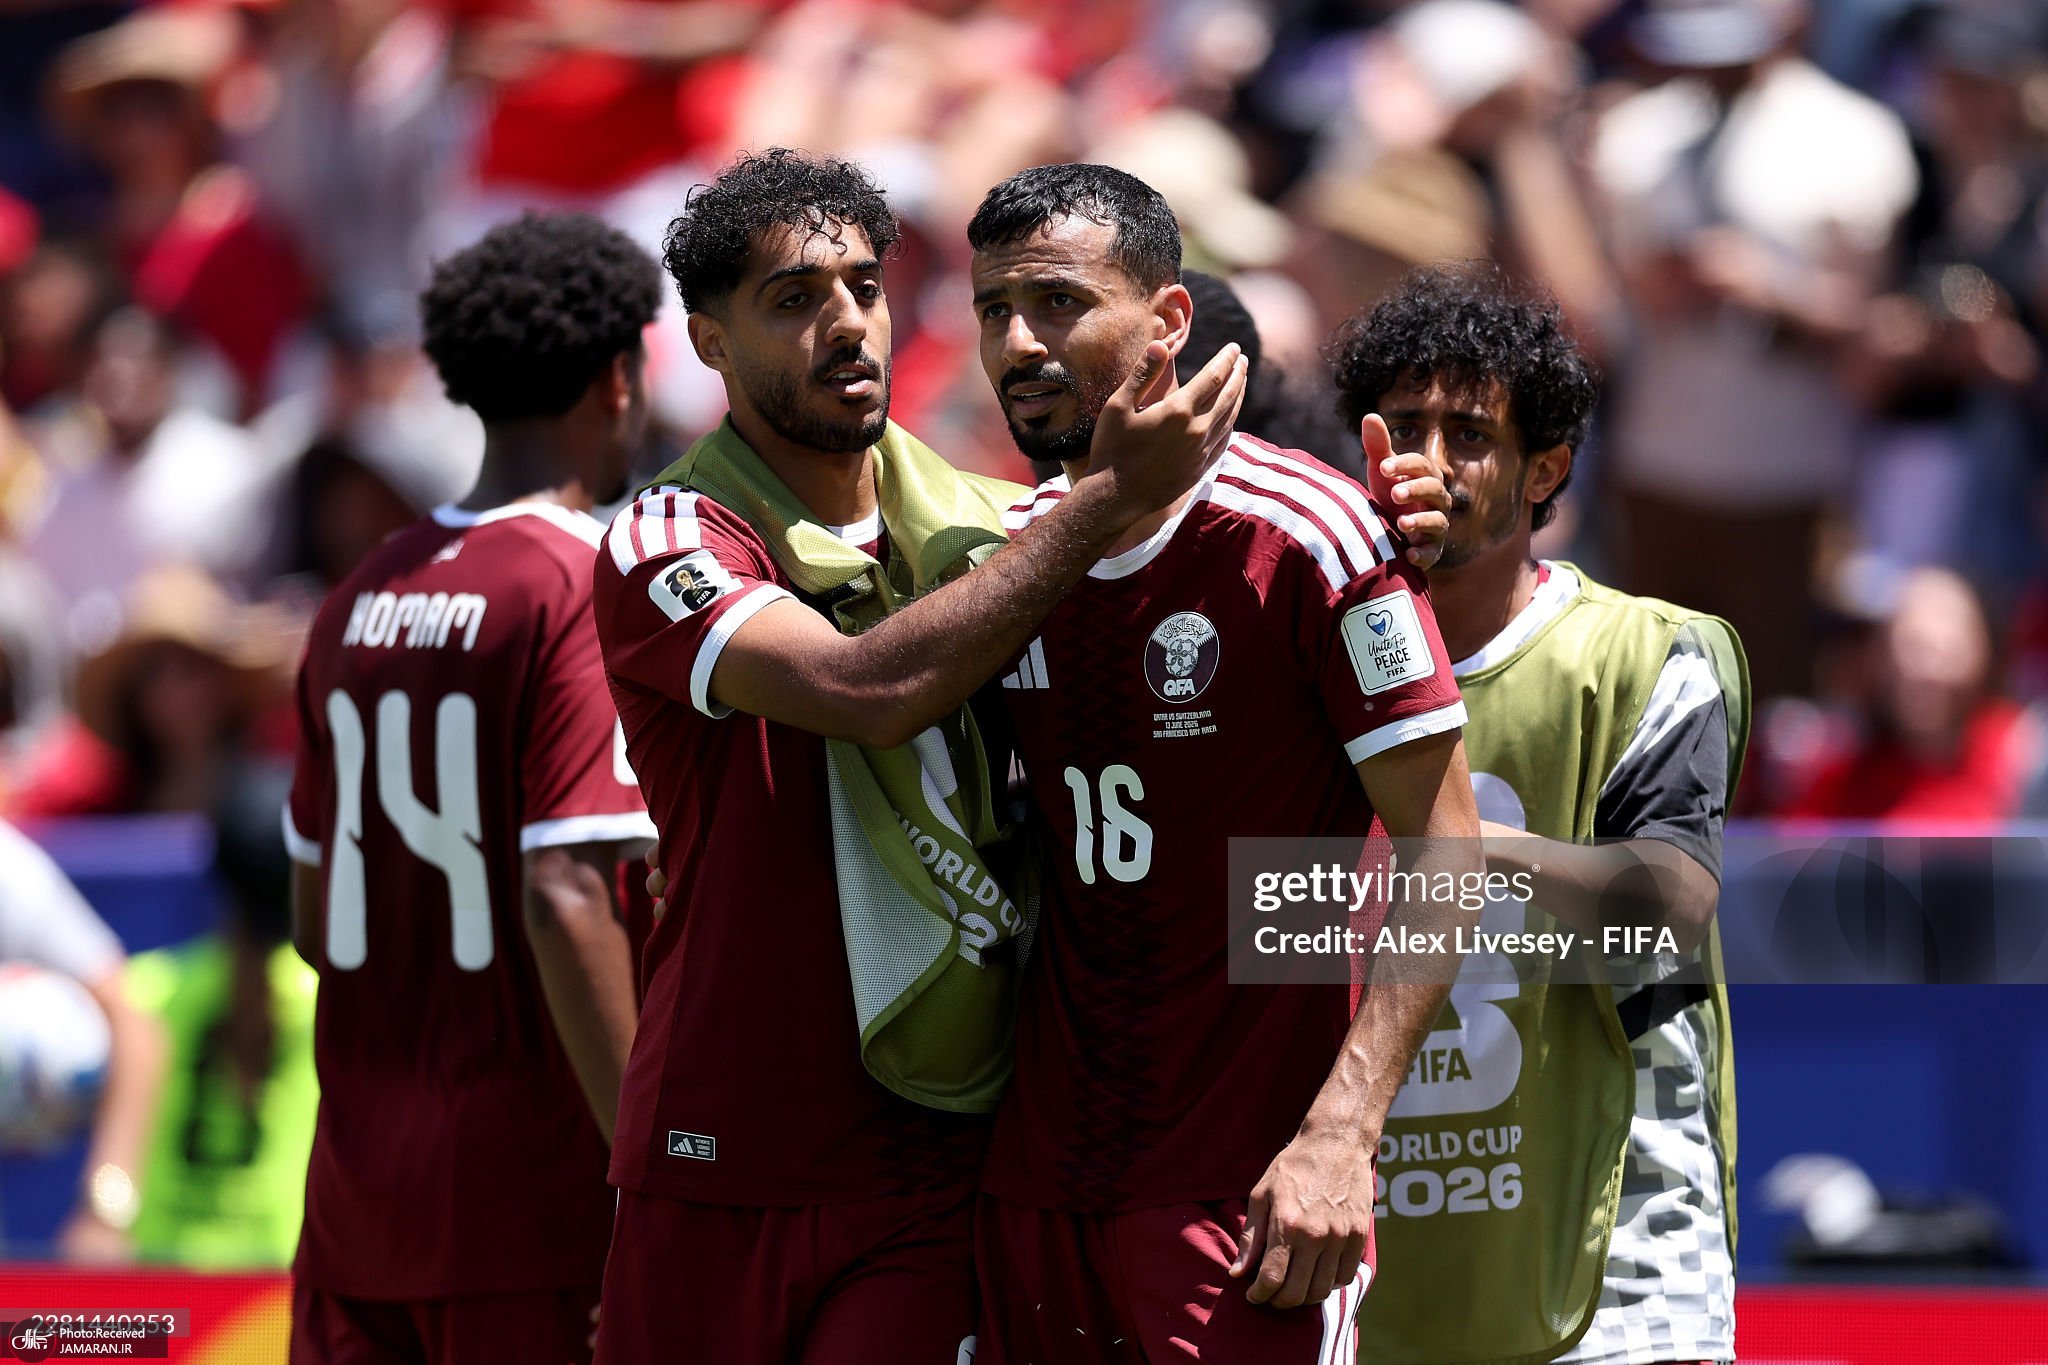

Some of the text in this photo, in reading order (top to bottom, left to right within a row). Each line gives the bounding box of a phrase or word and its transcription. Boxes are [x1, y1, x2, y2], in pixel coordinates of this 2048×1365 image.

[697, 590, 711, 604] FIFA
[344, 591, 487, 652] HOMAM
[1368, 633, 1406, 656] Unite For
[1375, 648, 1411, 671] PEACE
[1386, 667, 1406, 678] FIFA
[1163, 678, 1196, 696] QFA
[1153, 713, 1168, 721] QATAR
[1175, 710, 1212, 720] SWITZERLAND
[1171, 721, 1183, 729] JUNE
[1184, 720, 1199, 728] 2026
[1163, 730, 1188, 738] FRANCISCO
[326, 689, 495, 970] 14
[1064, 764, 1153, 884] 16
[1377, 1125, 1522, 1163] ORLD CUP
